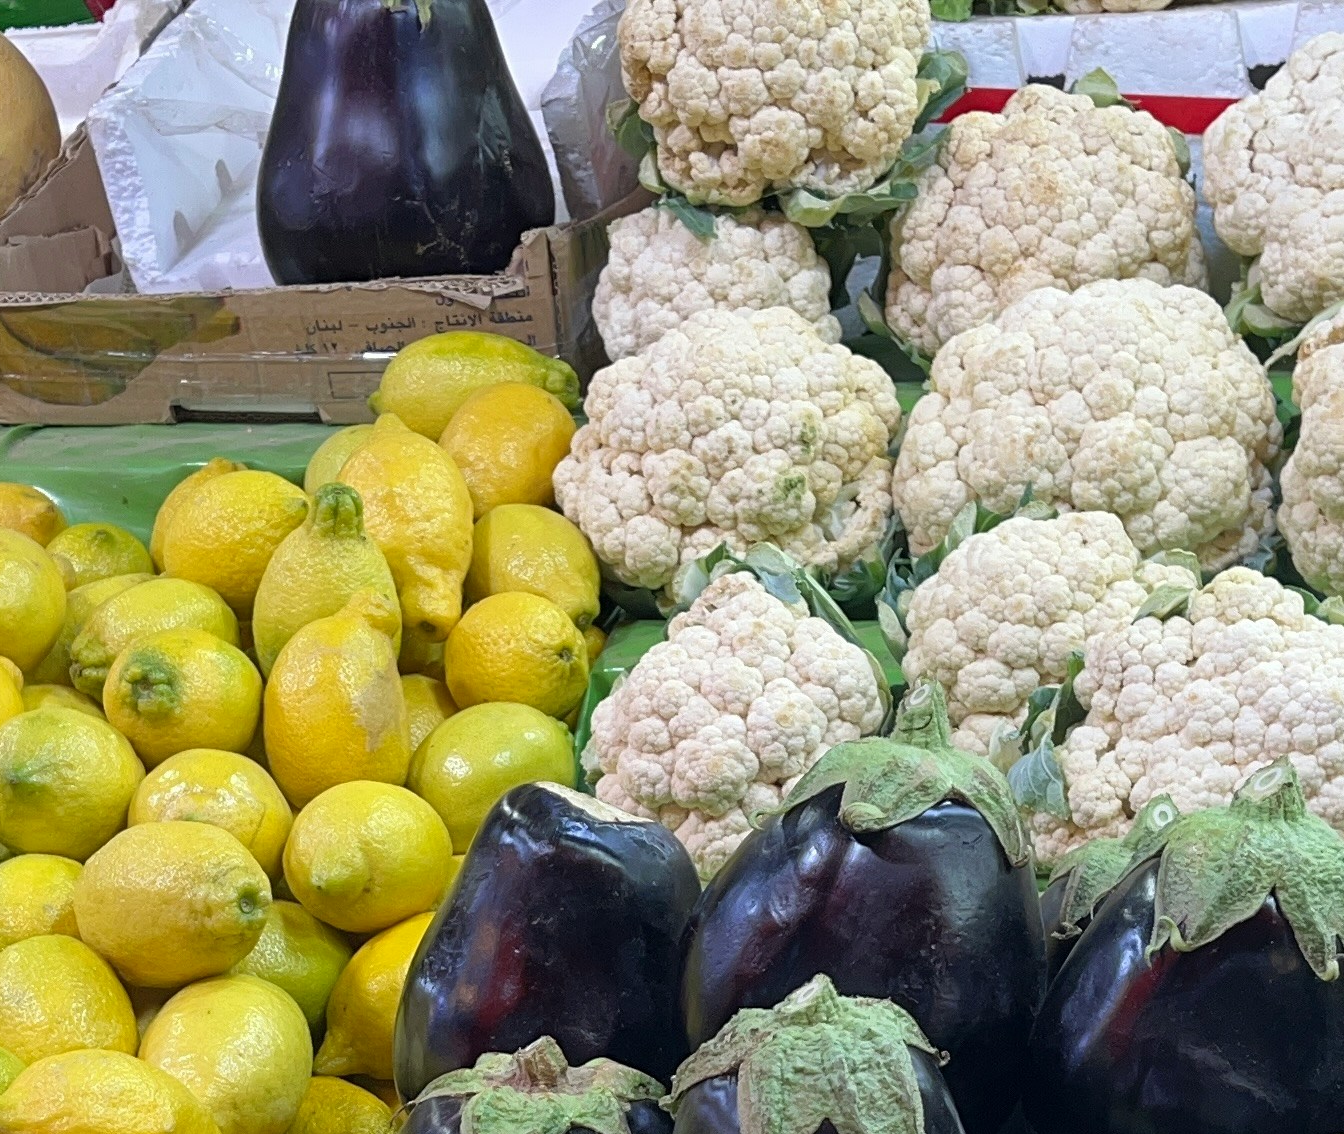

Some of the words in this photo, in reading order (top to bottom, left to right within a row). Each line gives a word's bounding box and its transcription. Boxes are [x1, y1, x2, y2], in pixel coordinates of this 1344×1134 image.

[366, 317, 416, 335] الجنوب
[434, 312, 482, 333] الانتاج
[489, 310, 533, 324] منطقة
[305, 318, 343, 336] لبنان
